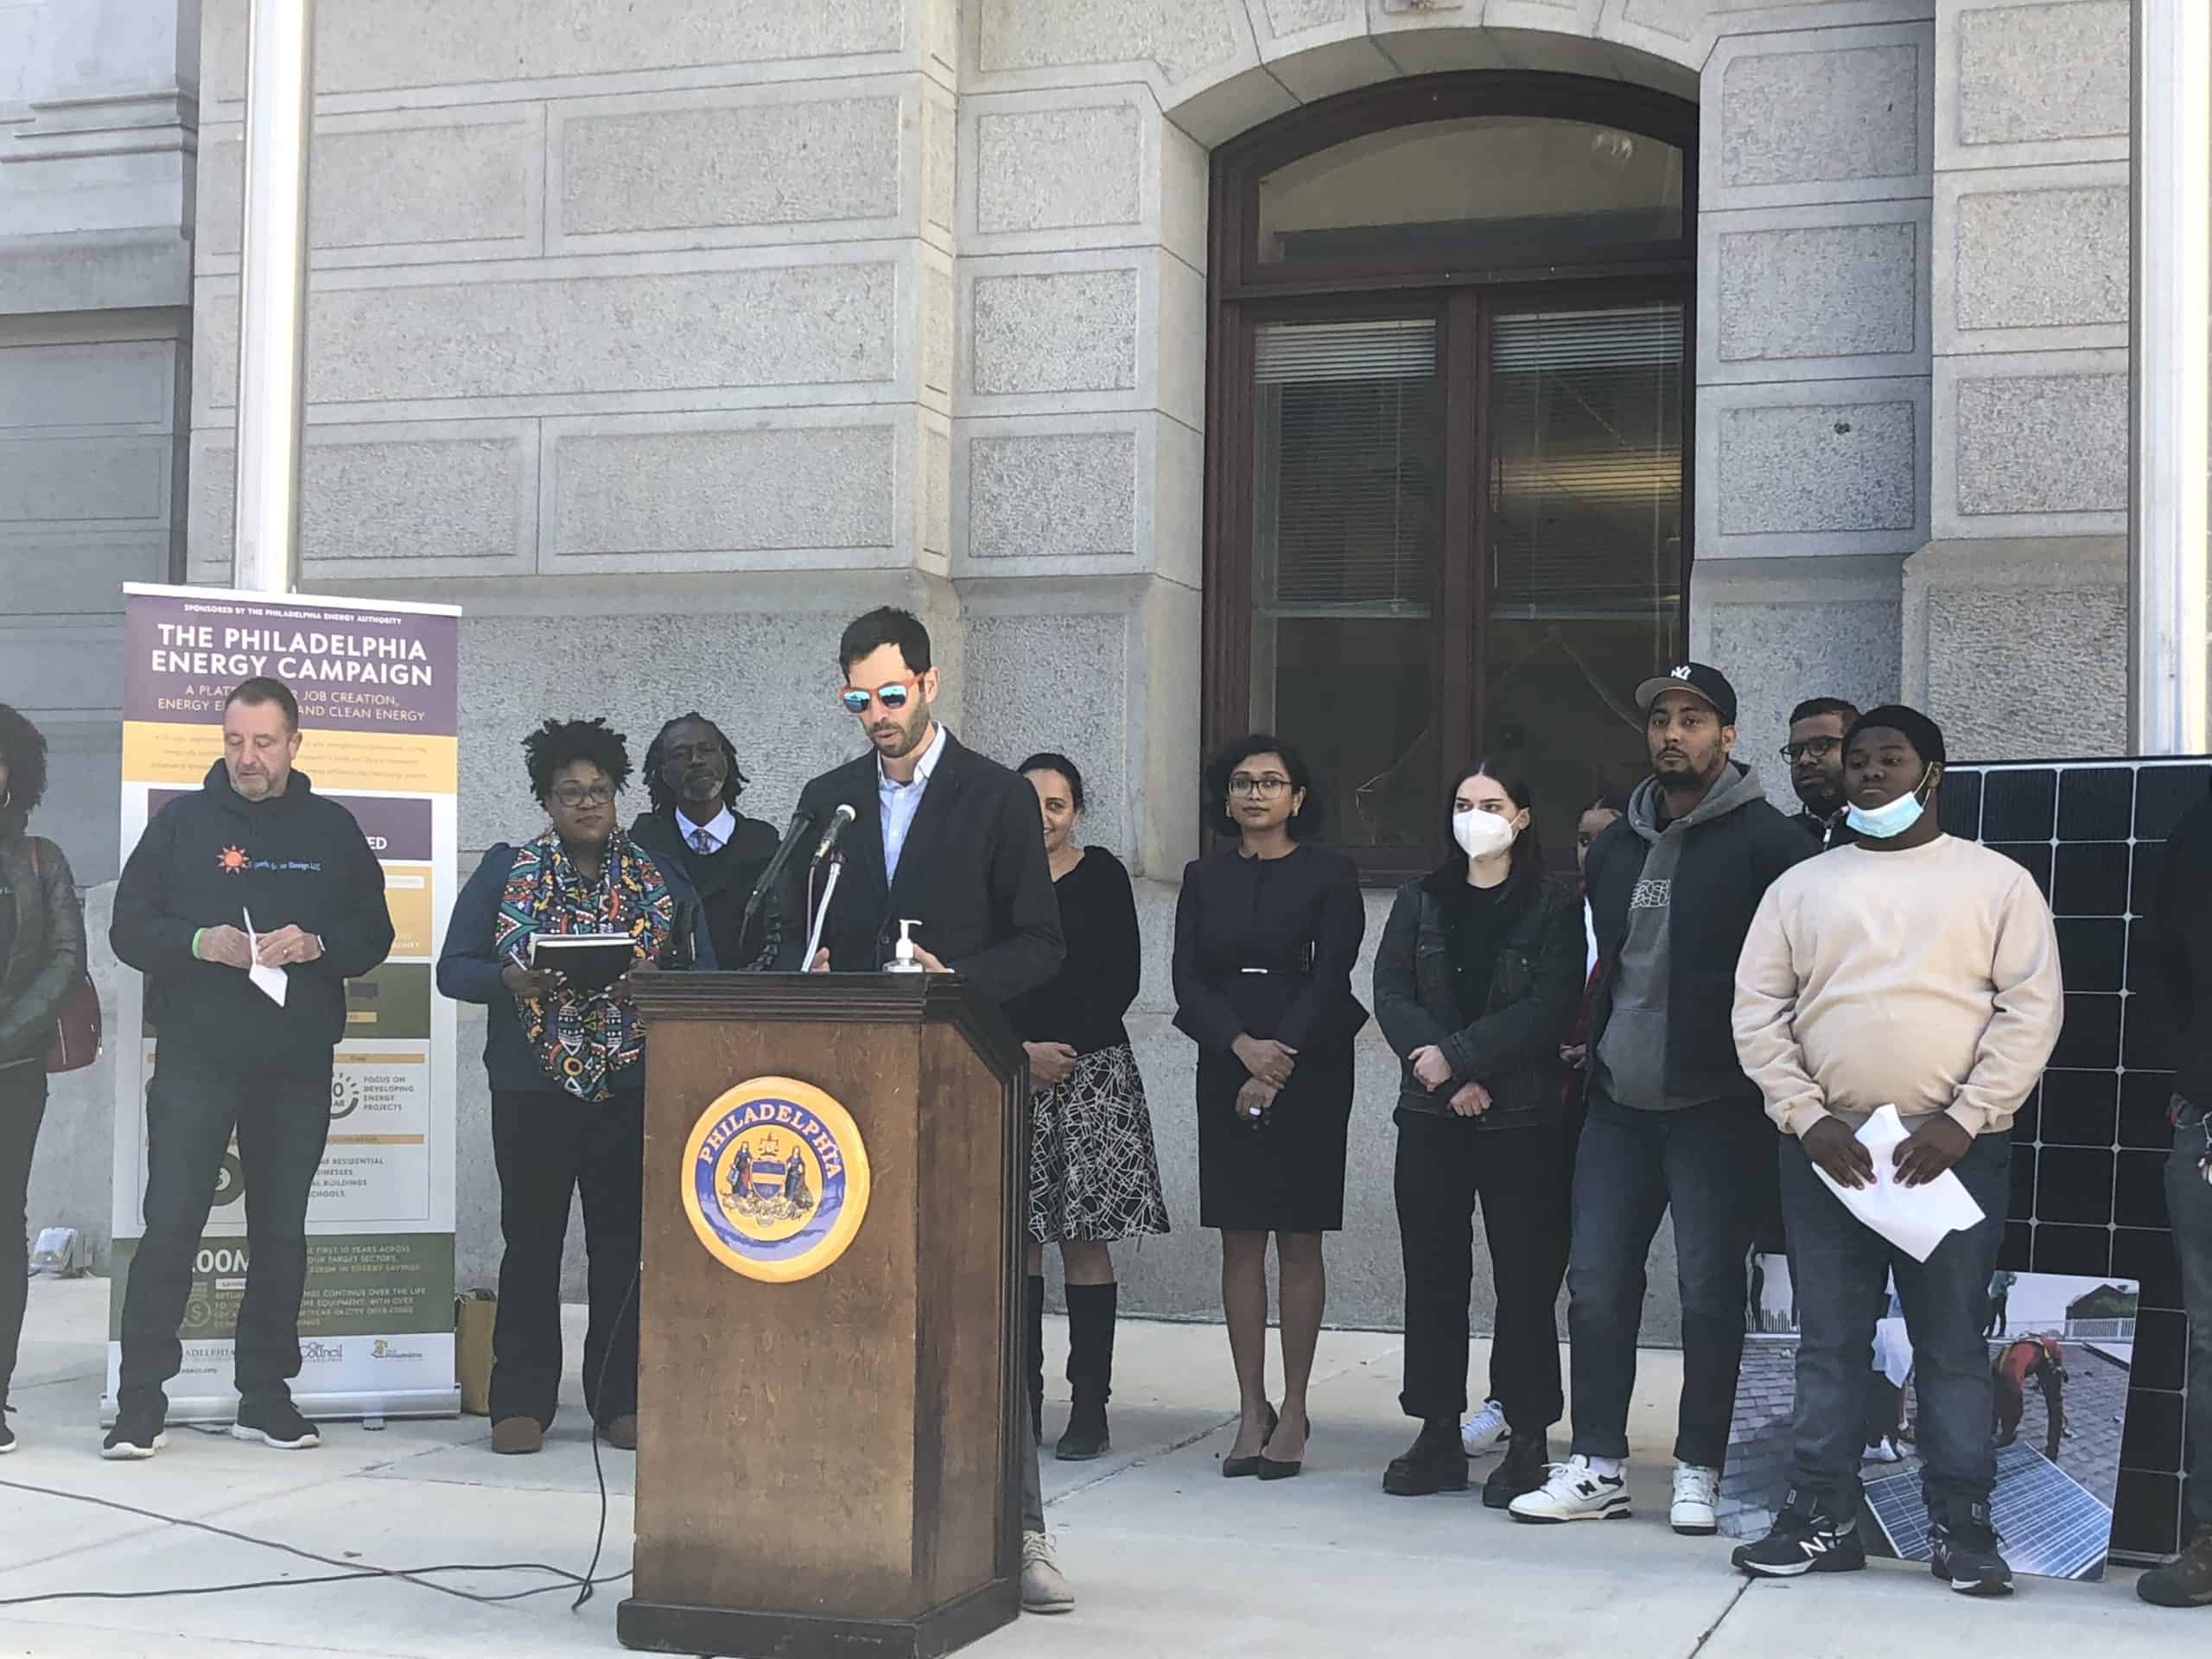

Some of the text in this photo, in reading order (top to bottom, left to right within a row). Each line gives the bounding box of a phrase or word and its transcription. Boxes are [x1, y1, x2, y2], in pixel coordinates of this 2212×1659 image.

[184, 604, 233, 614] SPONSORED
[265, 608, 321, 620] PHILADELPHIA
[323, 613, 354, 622] ENERGY
[357, 614, 401, 625] AUTHORITY
[157, 623, 428, 661] THE PHILADELPHIA
[151, 650, 432, 686] ENERGY CAMPAIGN
[185, 683, 194, 696] A
[303, 690, 327, 702] JOB
[331, 691, 400, 706] CREATION,
[158, 698, 209, 711] ENERGY
[297, 705, 425, 721] AND CLEAN ENERGY
[699, 1103, 842, 1179] PHILADELPHIA
